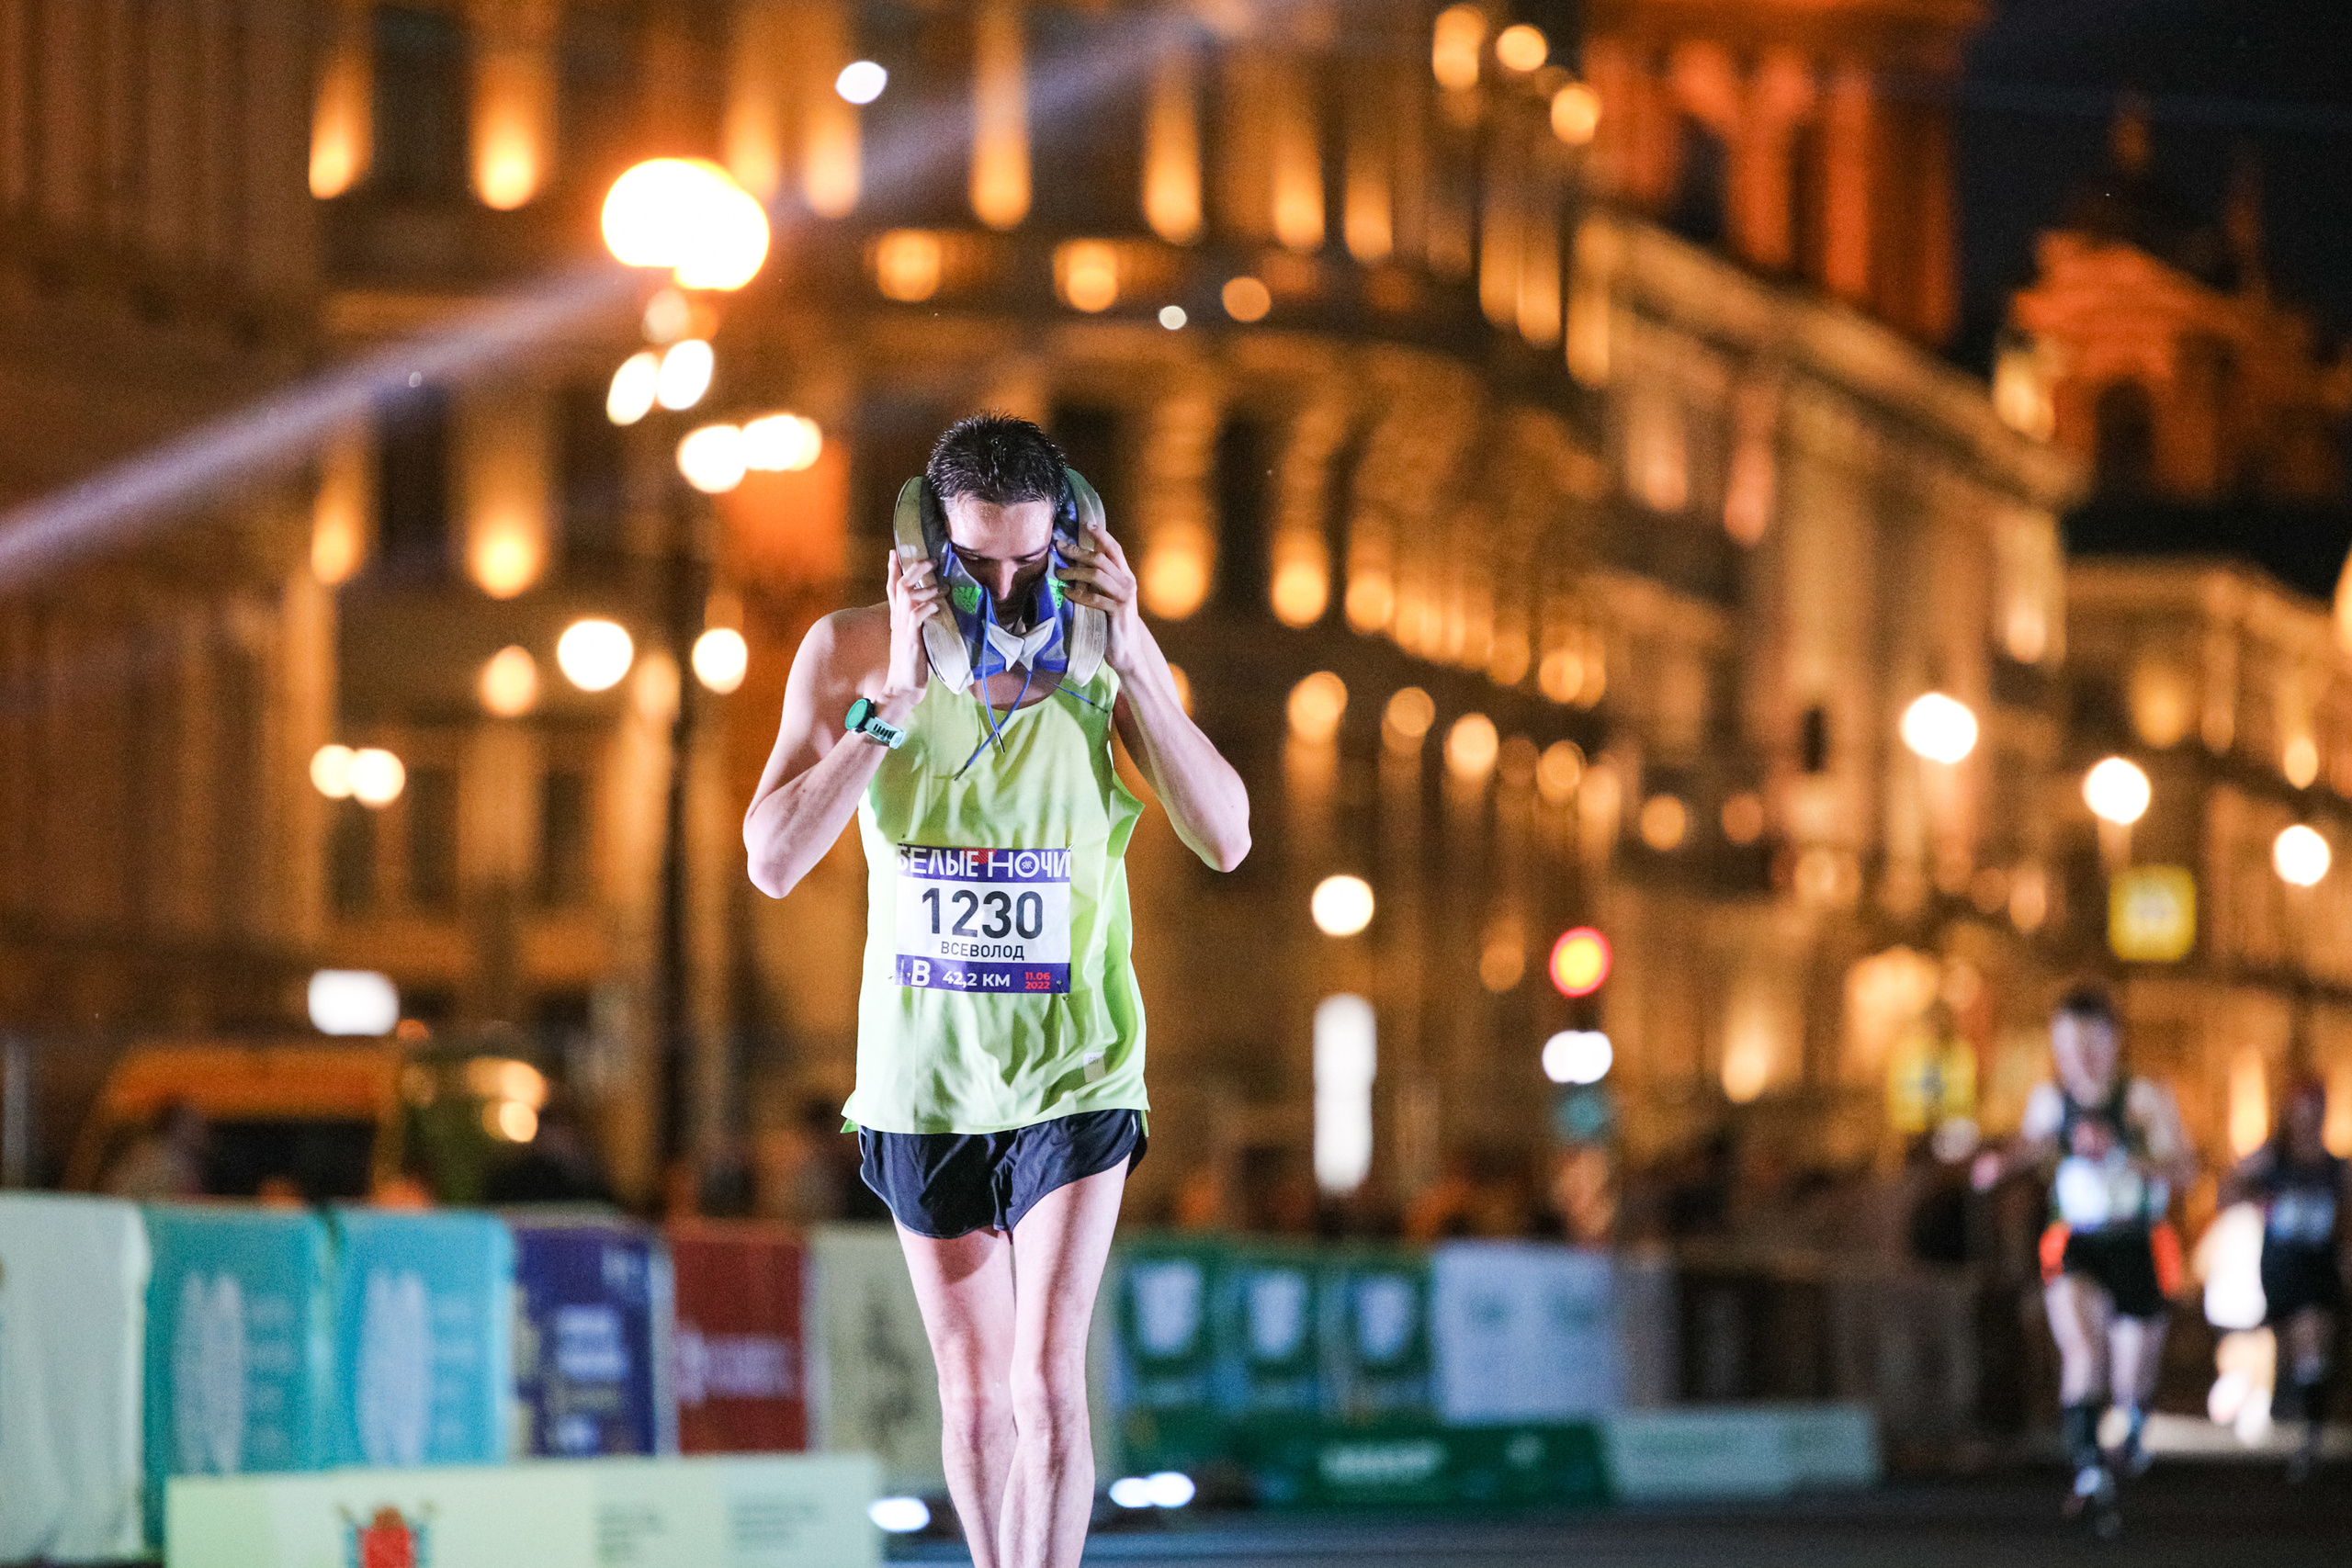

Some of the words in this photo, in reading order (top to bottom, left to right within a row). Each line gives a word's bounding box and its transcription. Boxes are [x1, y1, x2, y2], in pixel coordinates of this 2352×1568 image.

[897, 845, 978, 877] БЕЛЫЕ
[987, 851, 1070, 878] НОЧИ
[922, 887, 1043, 940] 1230
[941, 941, 1024, 962] ВСЕВОЛОД
[942, 970, 978, 988] 42,2
[982, 974, 1011, 987] КМ
[1024, 972, 1051, 980] 11.06
[1024, 981, 1051, 989] 2022
